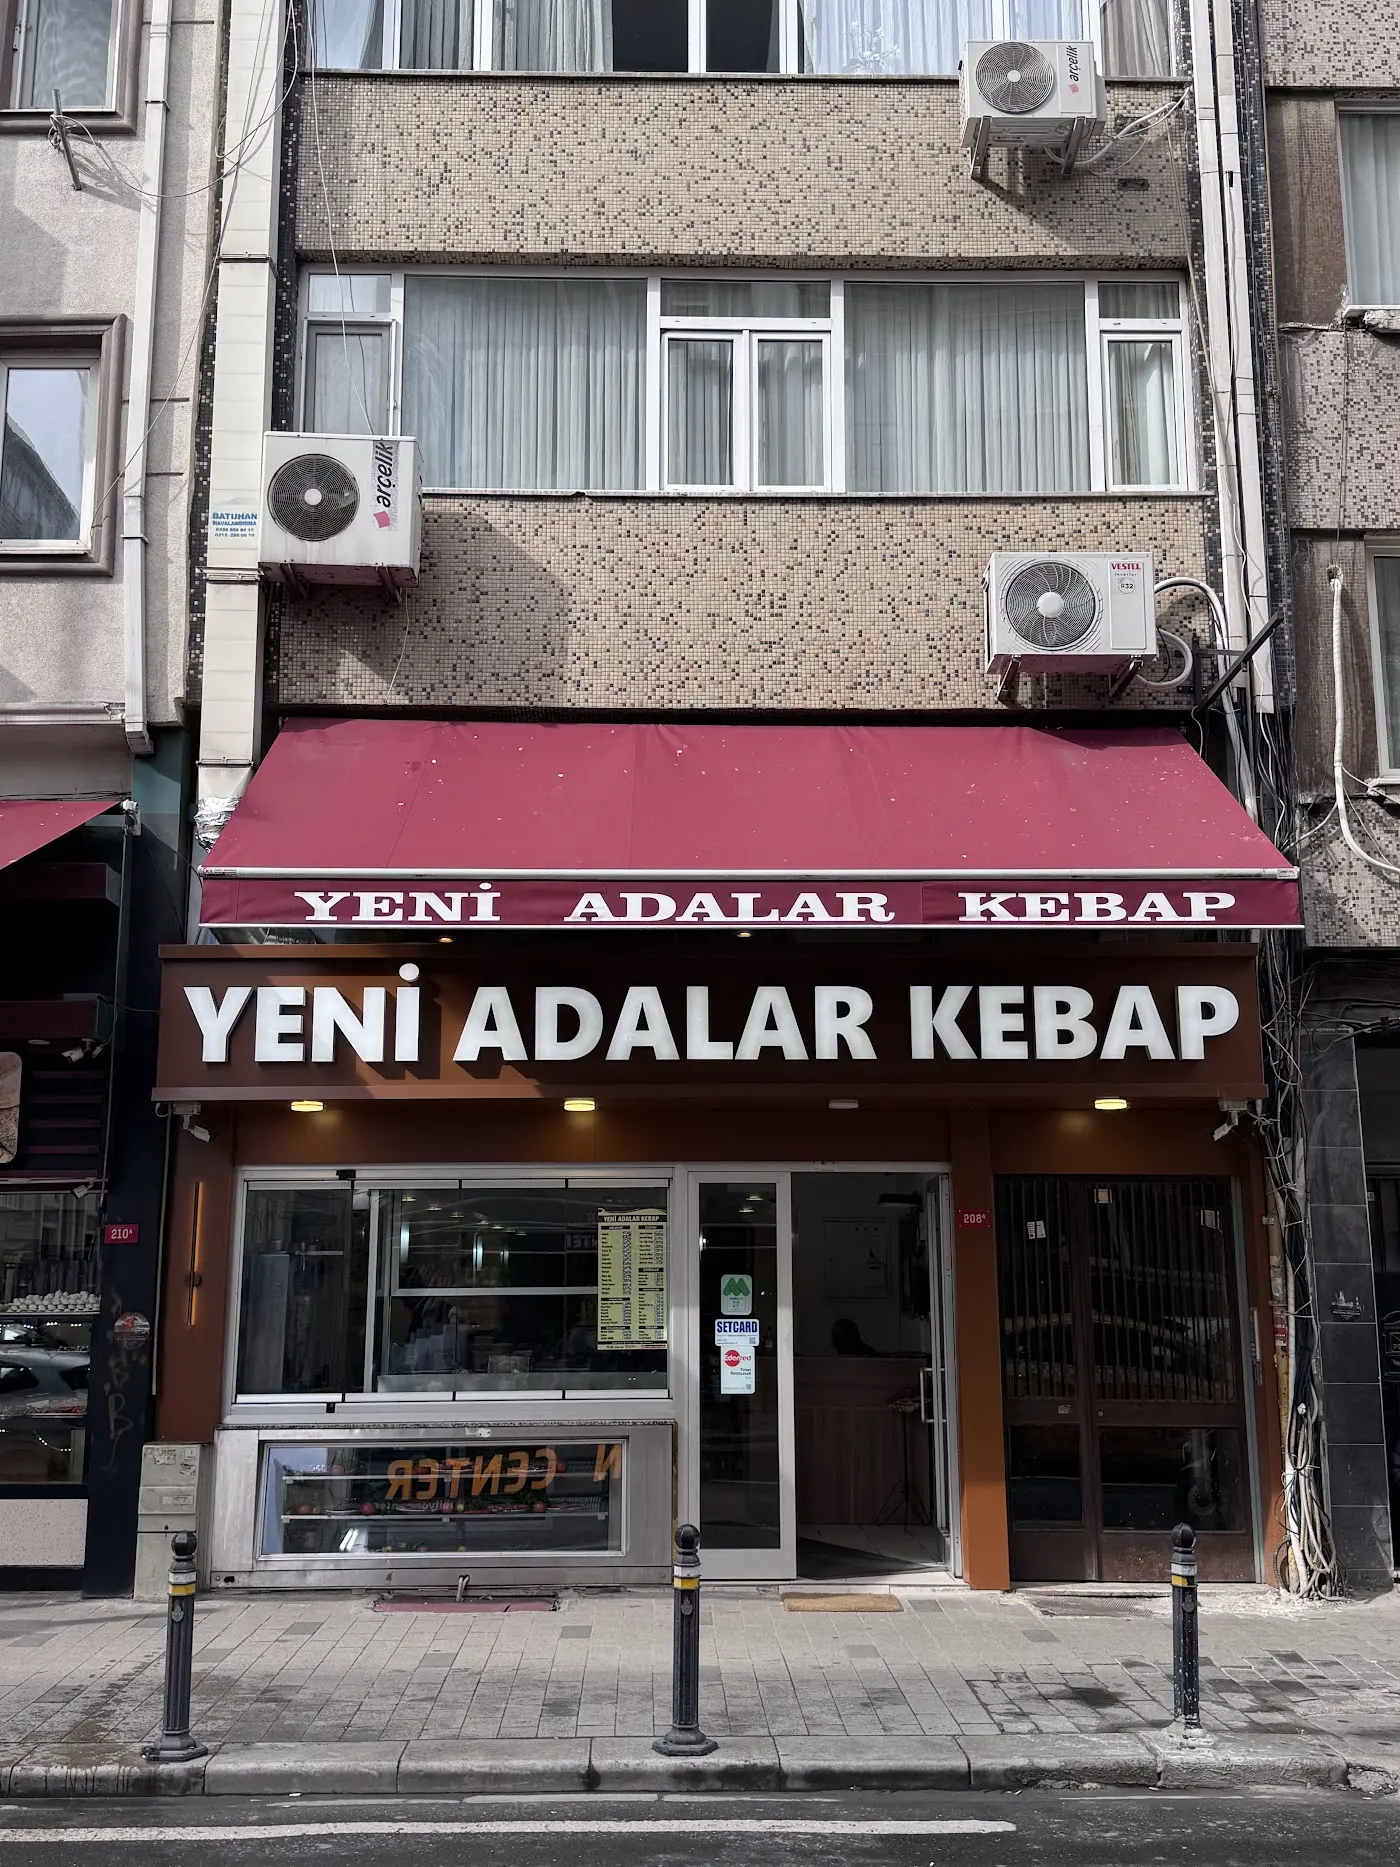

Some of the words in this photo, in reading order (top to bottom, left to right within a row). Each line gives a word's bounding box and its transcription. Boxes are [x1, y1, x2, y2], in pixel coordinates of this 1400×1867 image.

[1066, 45, 1081, 82] arçelik
[374, 441, 396, 508] arçelik
[212, 512, 258, 520] BATUHAN
[294, 882, 501, 922] YENİ
[564, 893, 896, 922] ADALAR
[958, 892, 1236, 922] KEBAP
[183, 963, 420, 1063] YENİ
[453, 985, 878, 1062] ADALAR
[909, 985, 1240, 1061] KEBAP
[716, 1321, 758, 1333] SETCARD
